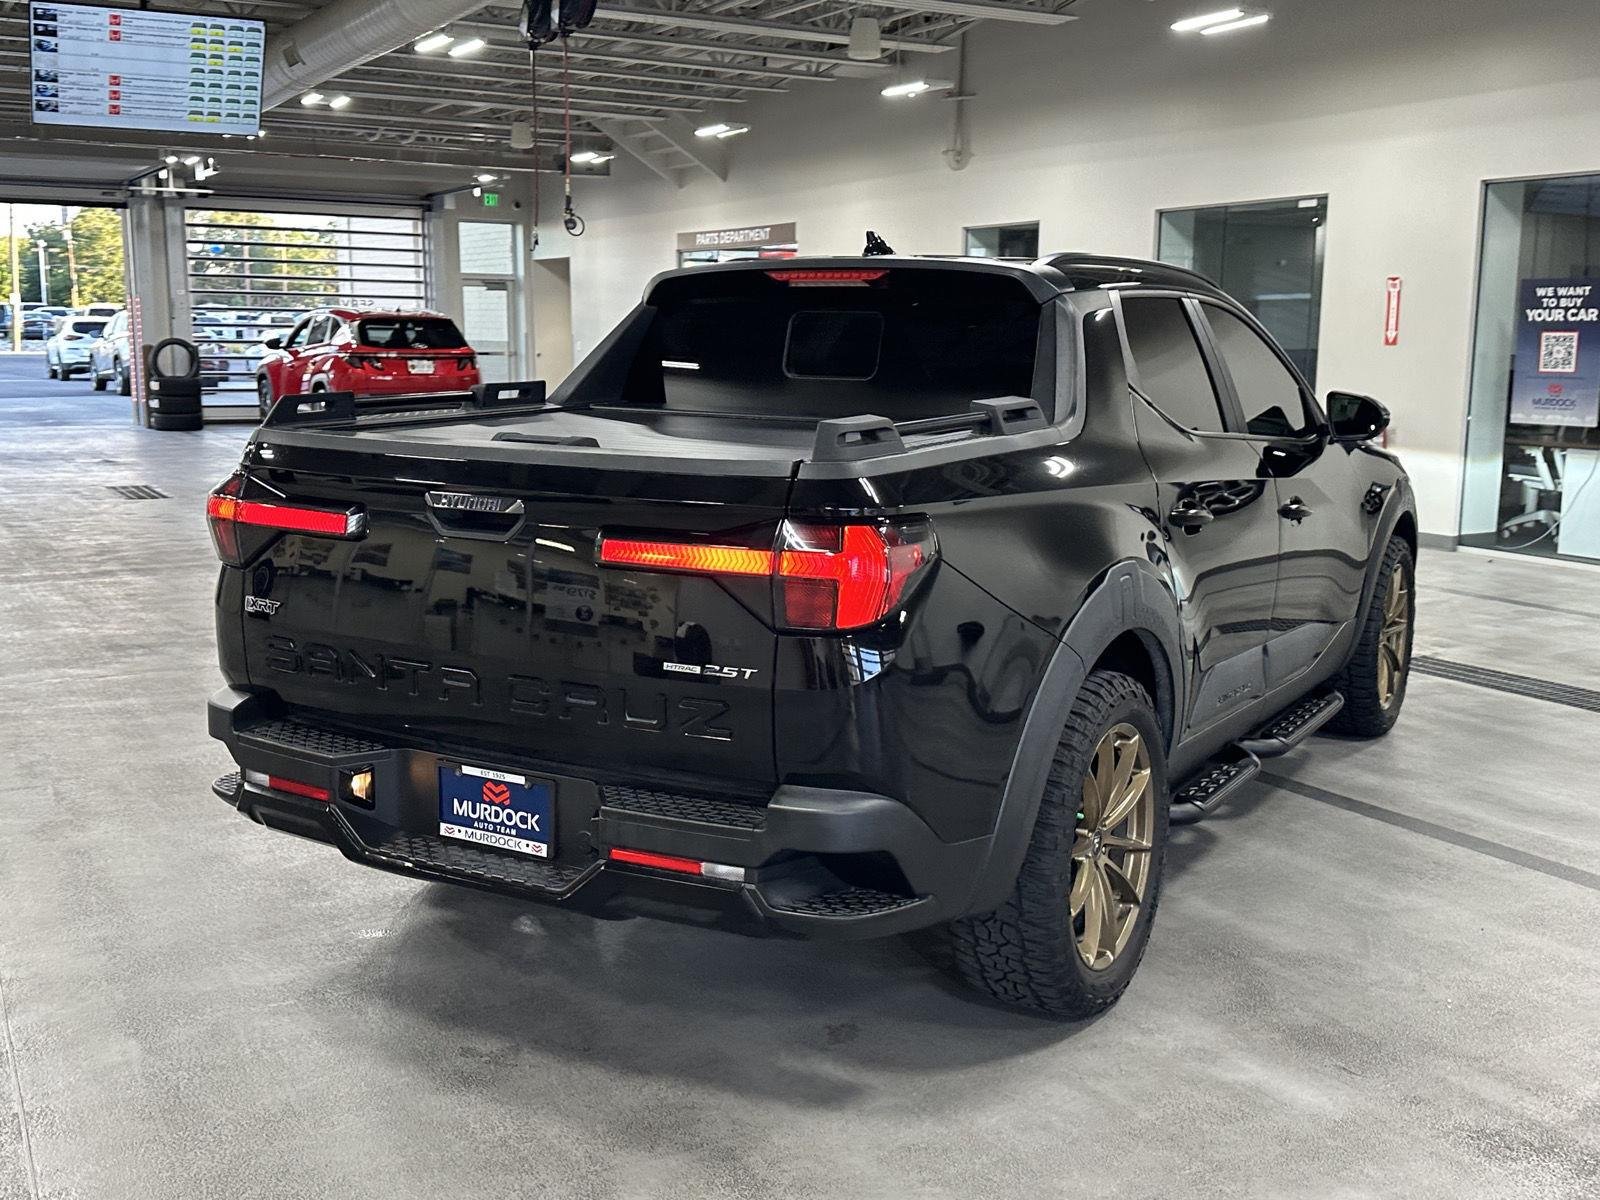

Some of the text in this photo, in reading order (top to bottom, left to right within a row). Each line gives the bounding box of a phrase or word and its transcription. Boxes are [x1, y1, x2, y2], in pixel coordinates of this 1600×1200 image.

[696, 228, 771, 245] PARTS DEPARTMENT
[1536, 286, 1592, 297] WE WANT
[1542, 297, 1584, 308] TO BUY
[1526, 308, 1599, 322] YOUR CAR
[440, 493, 502, 511] HYUNDAI
[245, 596, 280, 615] XRT
[264, 634, 484, 706] SANTA
[664, 663, 700, 673] HTRAC
[506, 673, 734, 743] CRUZ
[492, 772, 506, 780] 1925
[453, 798, 540, 832] MURDOCK
[473, 821, 517, 836] AUTO TEAM
[464, 829, 522, 850] MURDOCK
